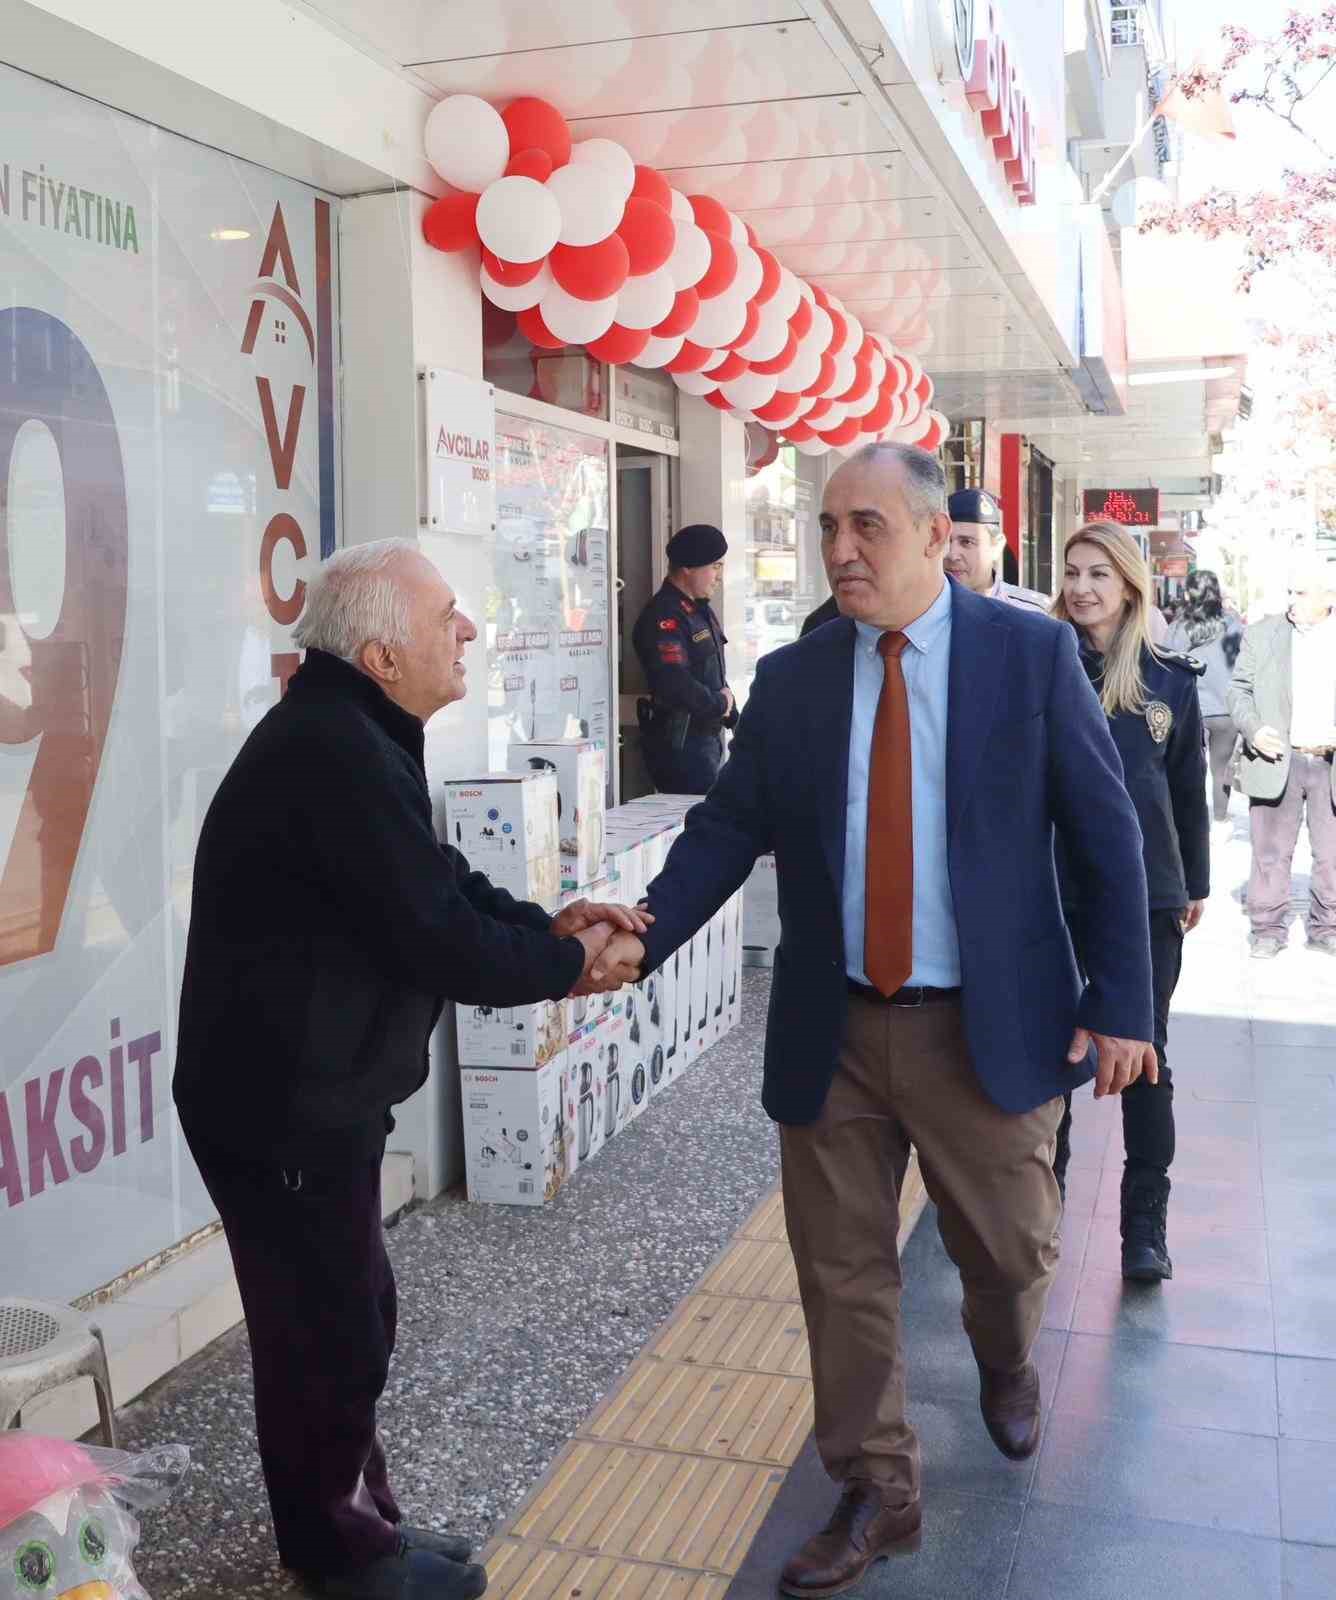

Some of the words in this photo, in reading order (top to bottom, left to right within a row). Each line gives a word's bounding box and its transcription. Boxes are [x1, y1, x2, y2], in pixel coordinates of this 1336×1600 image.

[22, 163, 139, 254] FİYATINA
[436, 423, 490, 461] AVCILAR
[474, 1074, 498, 1082] BOSCH
